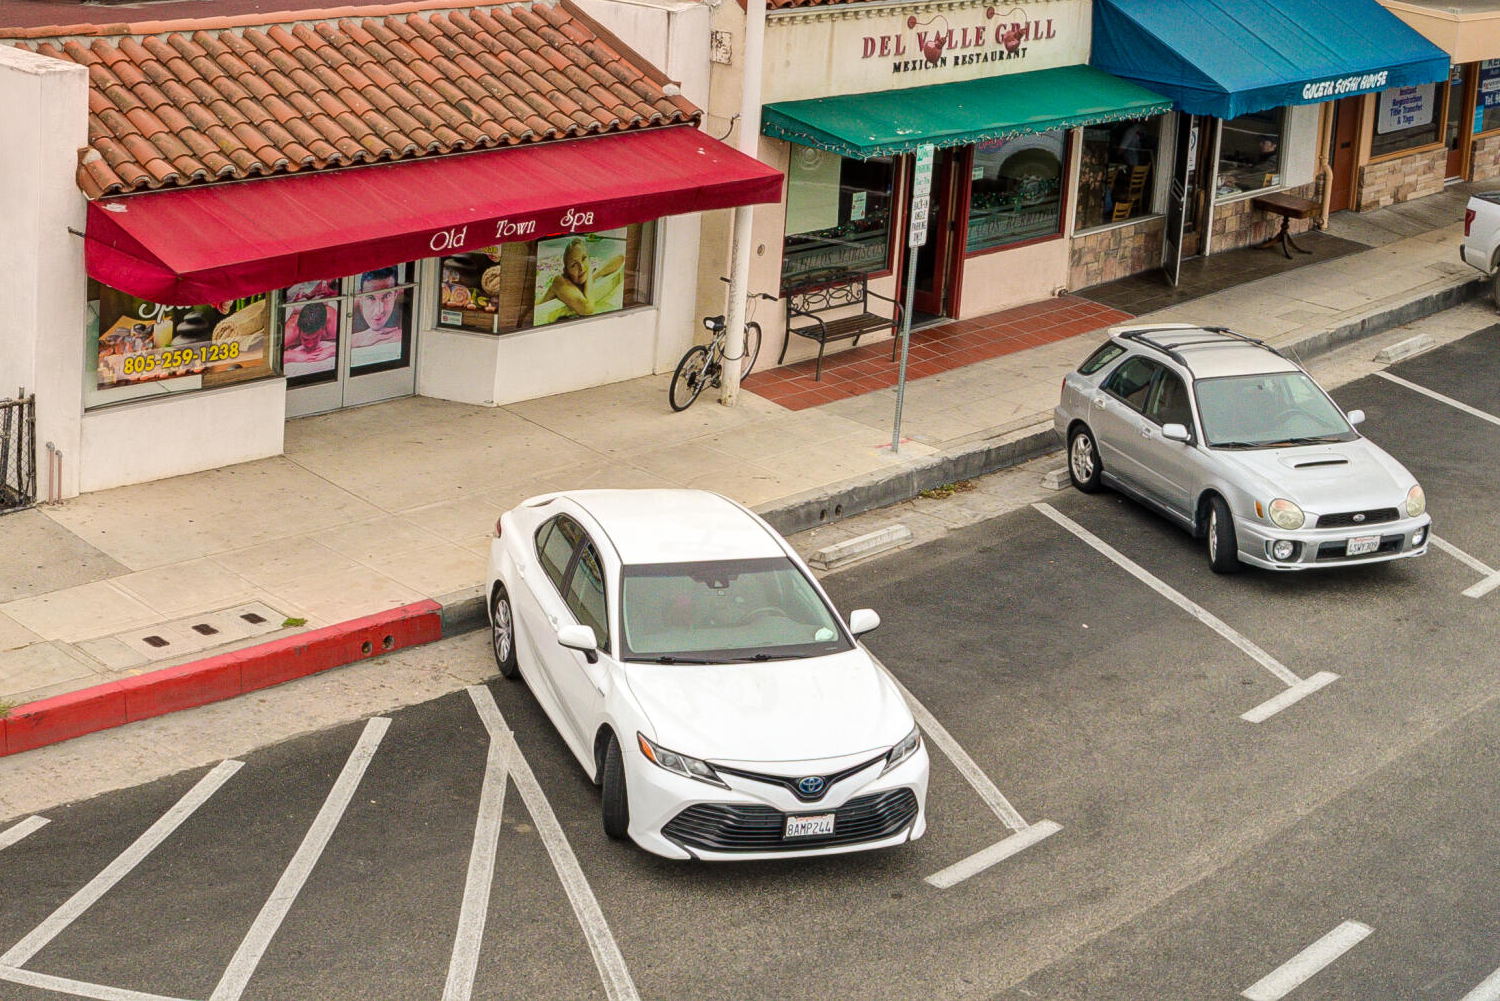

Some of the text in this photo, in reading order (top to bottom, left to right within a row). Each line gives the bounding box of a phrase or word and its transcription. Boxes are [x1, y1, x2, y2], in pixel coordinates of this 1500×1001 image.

[861, 34, 906, 59] DEL
[953, 47, 1028, 66] RESTAURANT
[1302, 70, 1388, 100] GOLETA SUSHI HOUSE
[430, 208, 594, 251] Old Town Spa
[124, 342, 239, 375] 805-259-1238
[787, 821, 831, 836] 8AMP244
